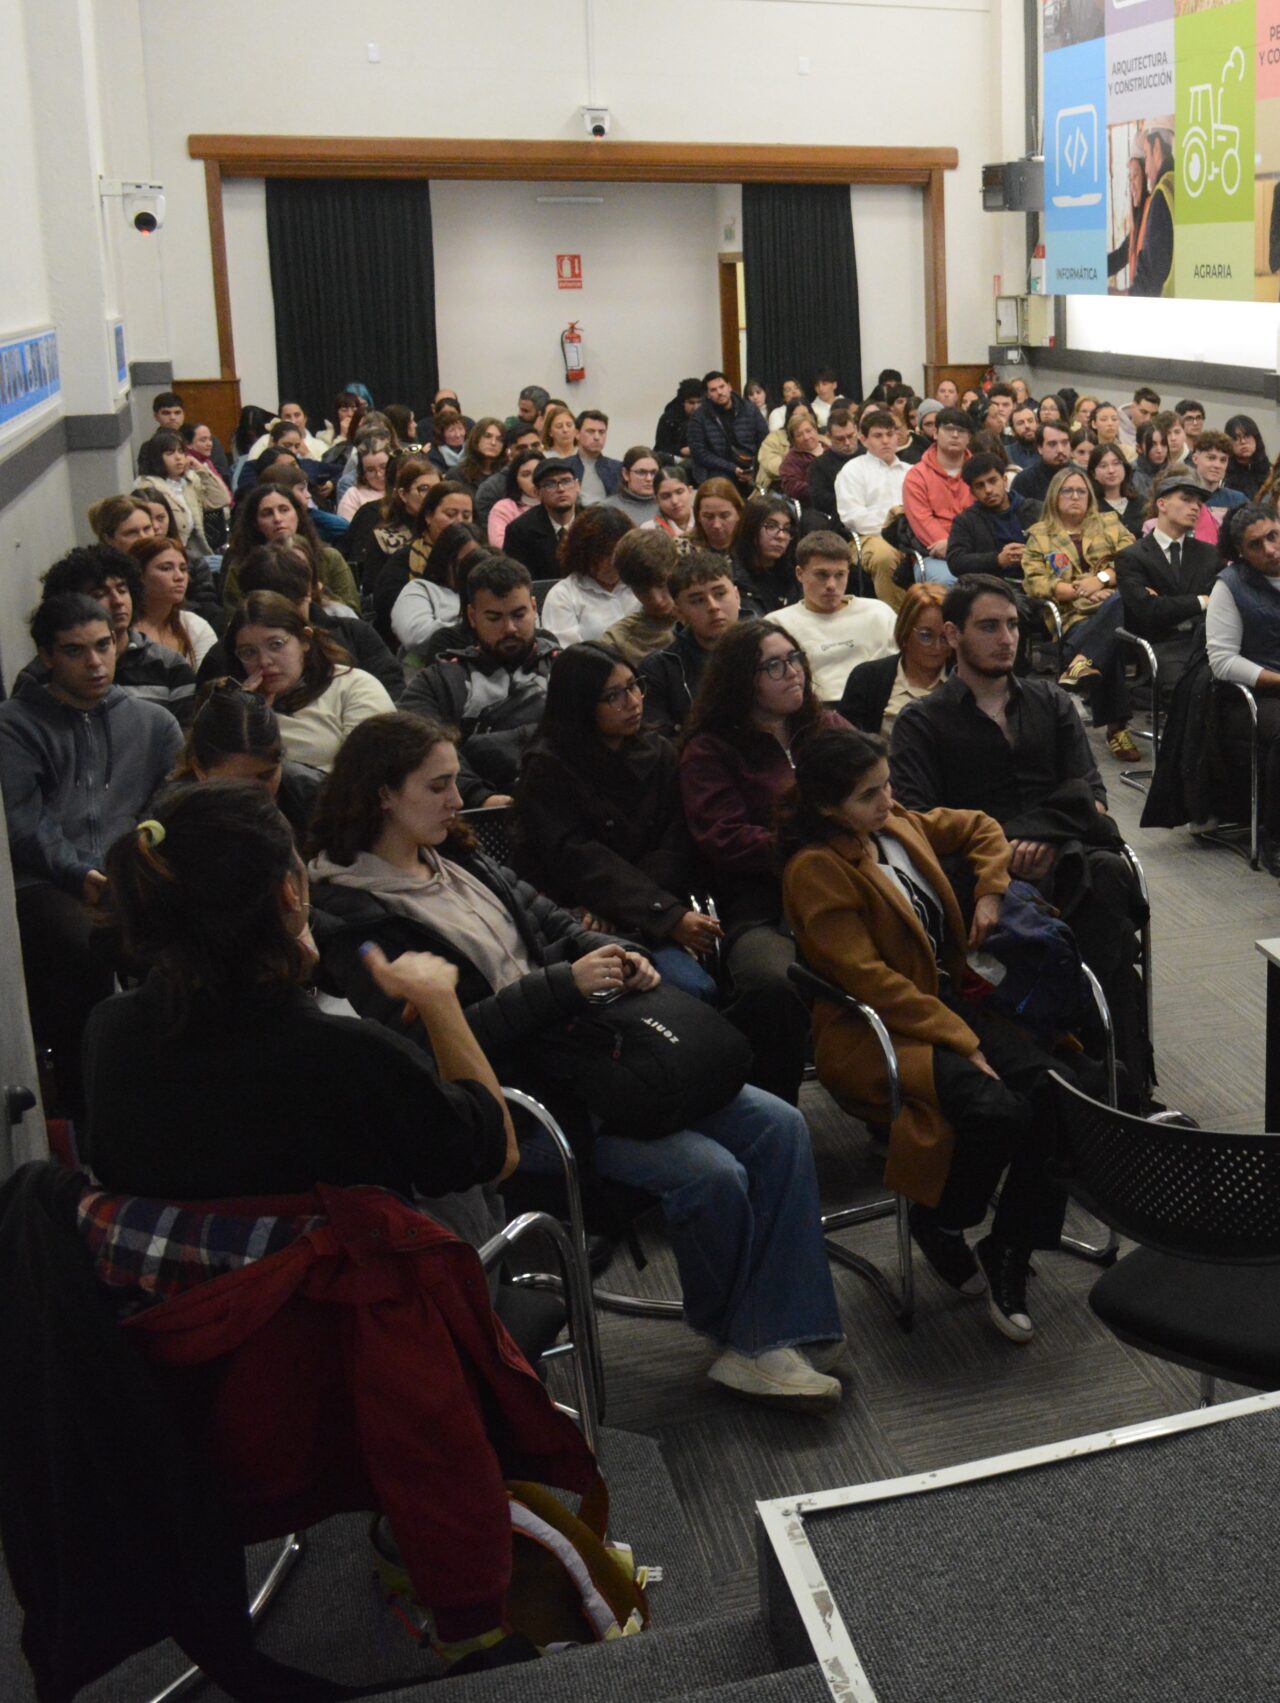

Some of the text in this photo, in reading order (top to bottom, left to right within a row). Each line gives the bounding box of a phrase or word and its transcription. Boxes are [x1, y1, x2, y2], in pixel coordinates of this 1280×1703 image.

[1111, 51, 1168, 76] ARQUITECTURA
[1259, 51, 1266, 66] Y
[1107, 67, 1173, 97] Y CONSTRUCCIÓN
[1055, 264, 1098, 281] INFORMÁTICA
[1193, 263, 1233, 280] AGRARIA
